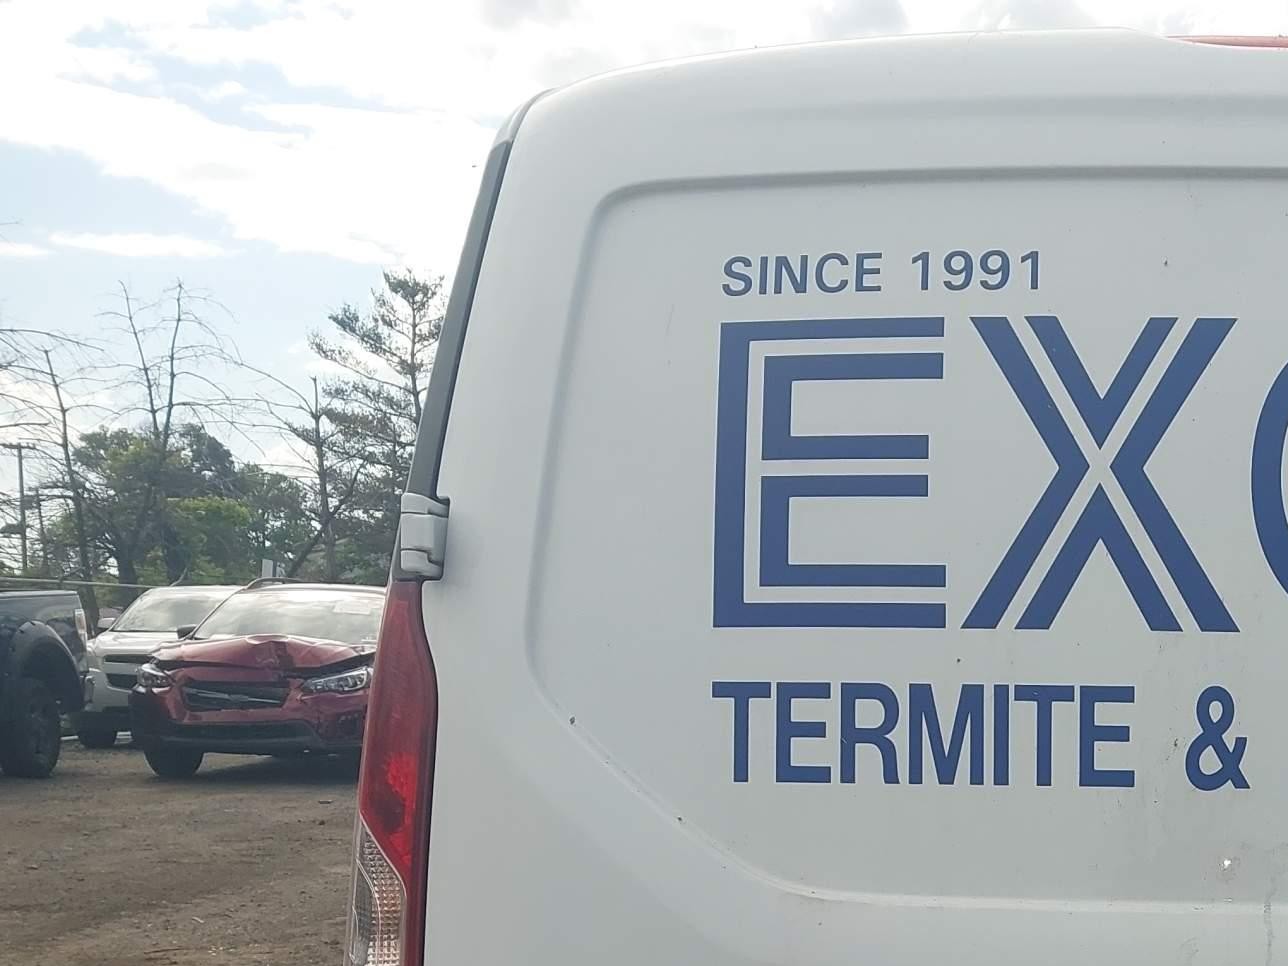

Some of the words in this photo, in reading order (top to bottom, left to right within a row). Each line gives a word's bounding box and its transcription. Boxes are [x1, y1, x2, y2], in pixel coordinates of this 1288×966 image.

[721, 252, 883, 297] SINCE
[910, 249, 1042, 292] 1991
[711, 682, 1136, 788] TERMITE
[1185, 686, 1250, 791] &
